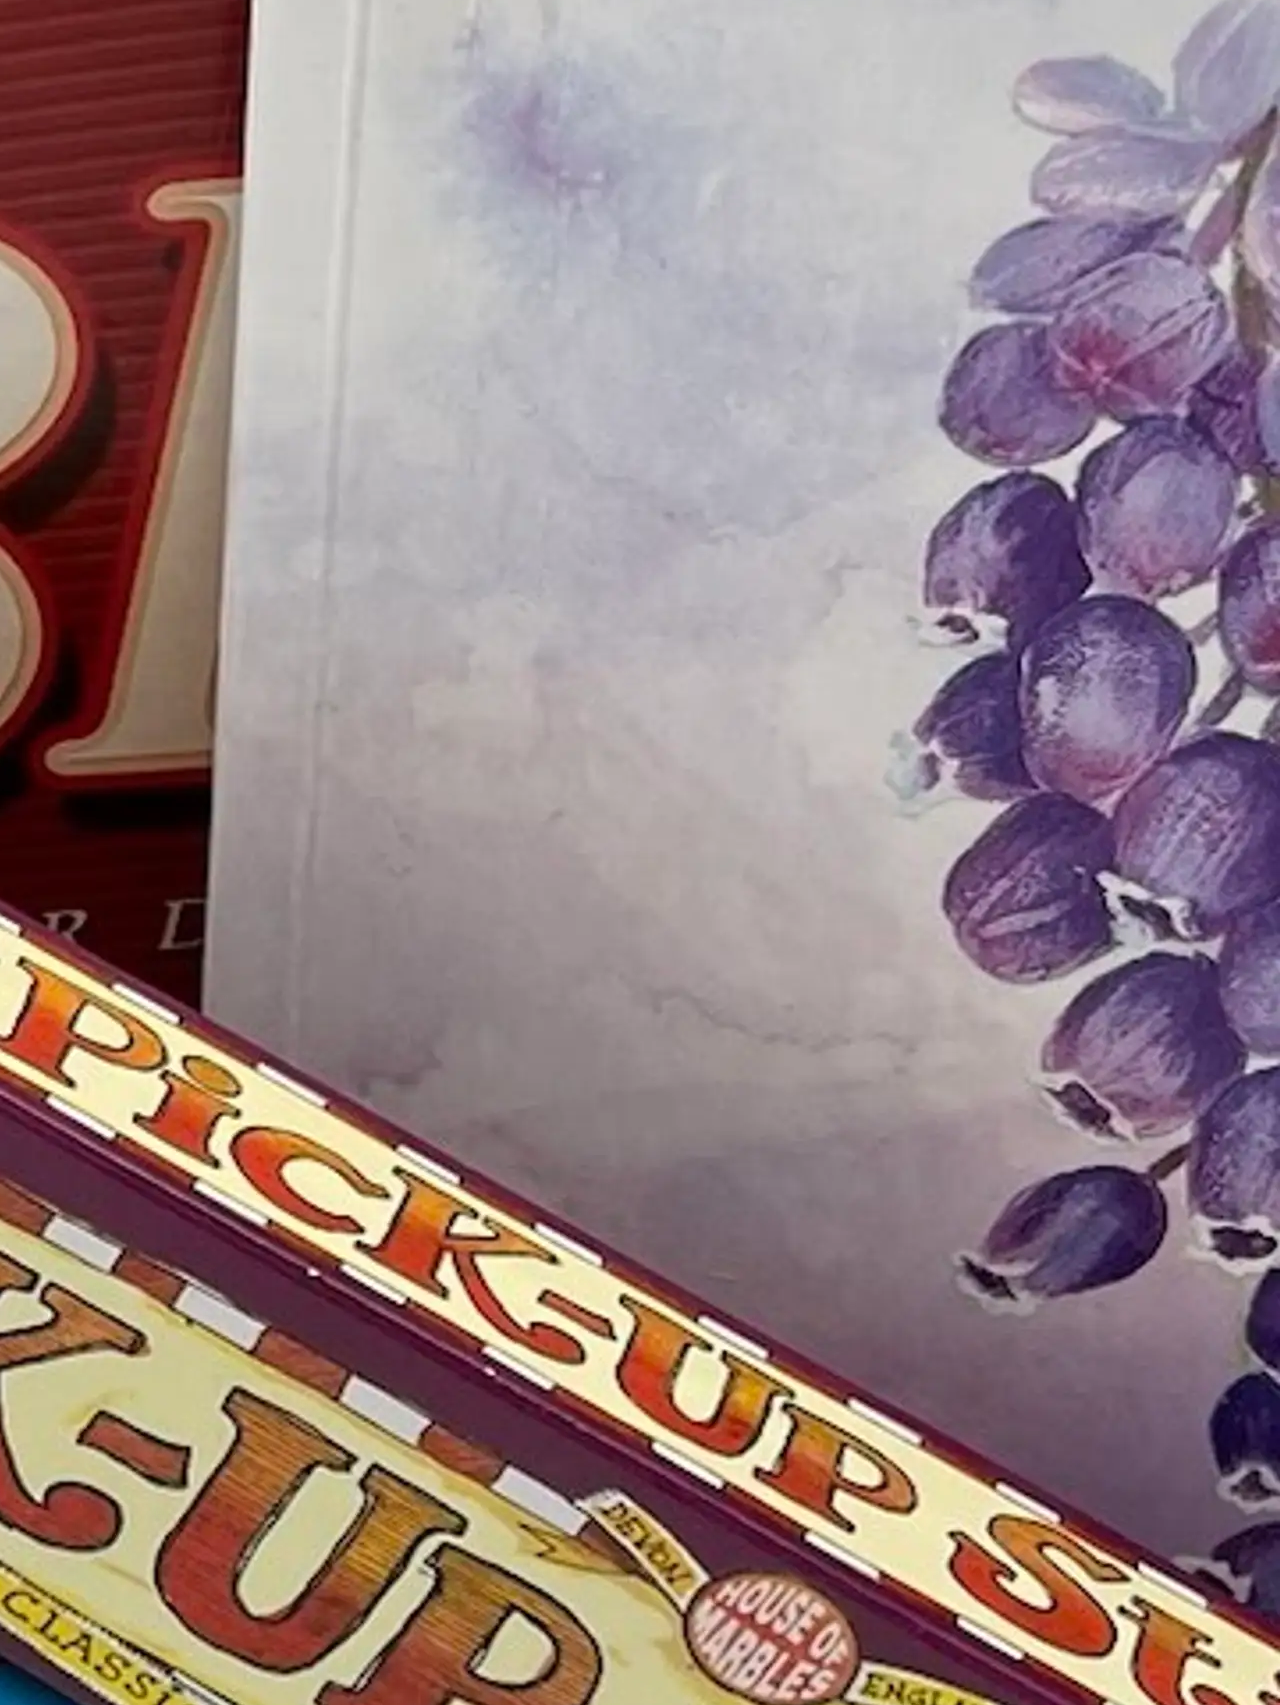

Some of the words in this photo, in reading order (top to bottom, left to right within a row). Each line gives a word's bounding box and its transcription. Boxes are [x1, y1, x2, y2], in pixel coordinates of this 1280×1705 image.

[692, 1603, 838, 1701] MARBLES
[716, 1579, 807, 1651] HOUSE
[808, 1618, 854, 1673] OF
